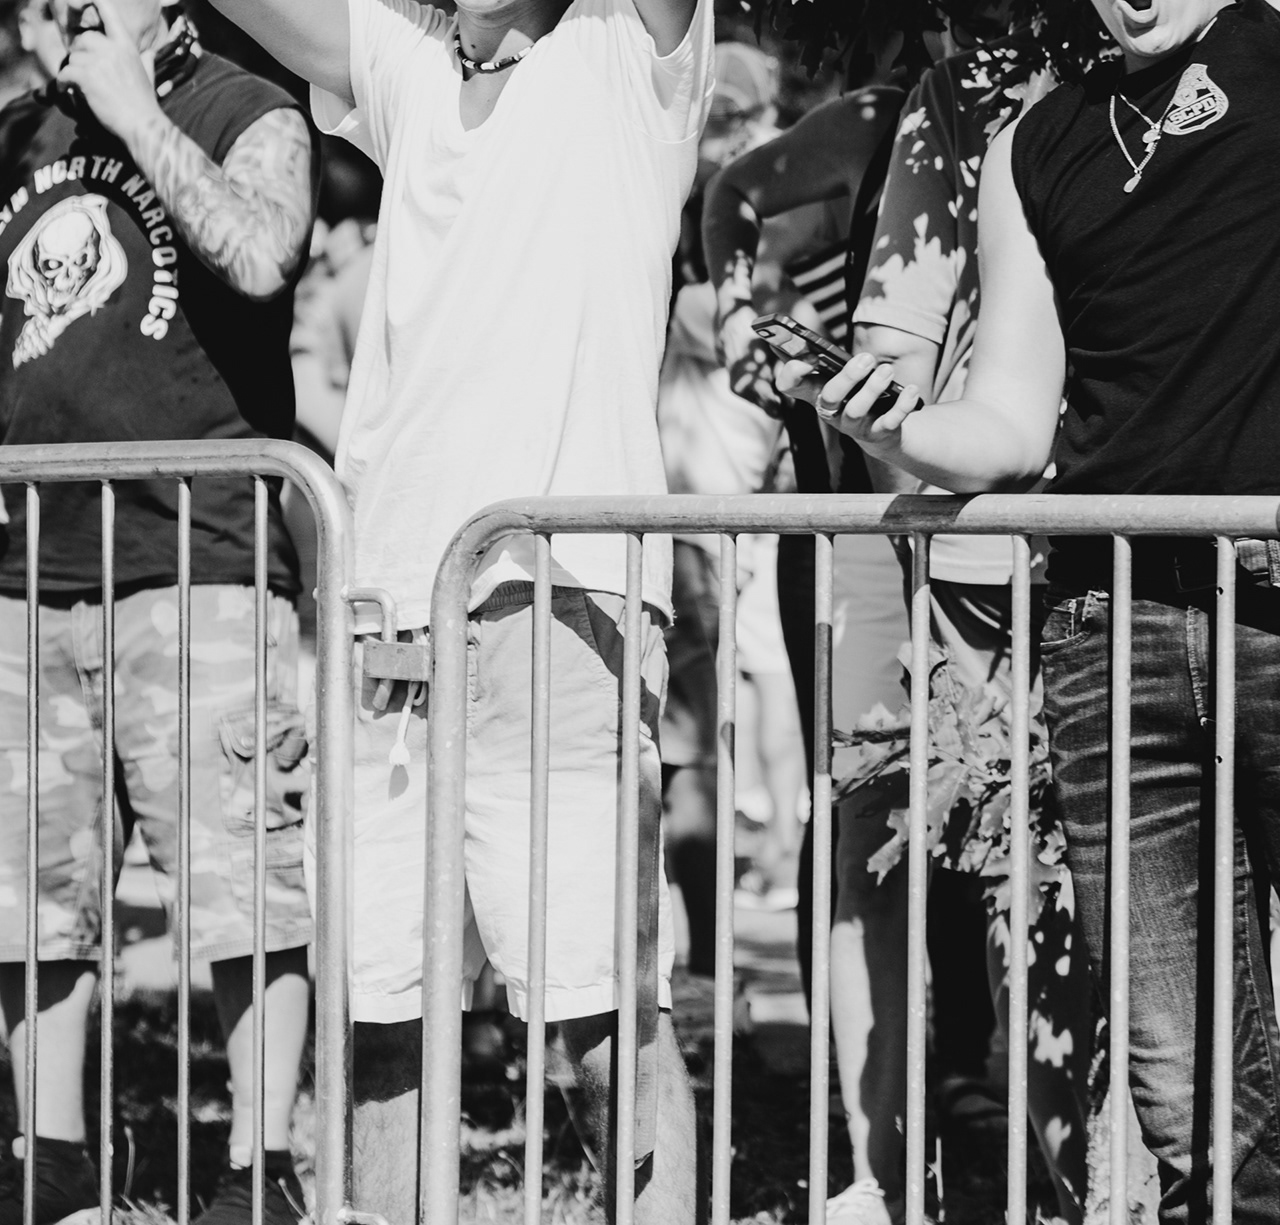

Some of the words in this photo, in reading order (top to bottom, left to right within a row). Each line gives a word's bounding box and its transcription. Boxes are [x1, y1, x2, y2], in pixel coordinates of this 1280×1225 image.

[1168, 97, 1217, 124] SCPD
[33, 155, 124, 194] NORTH
[120, 173, 179, 341] NARCOTICS
